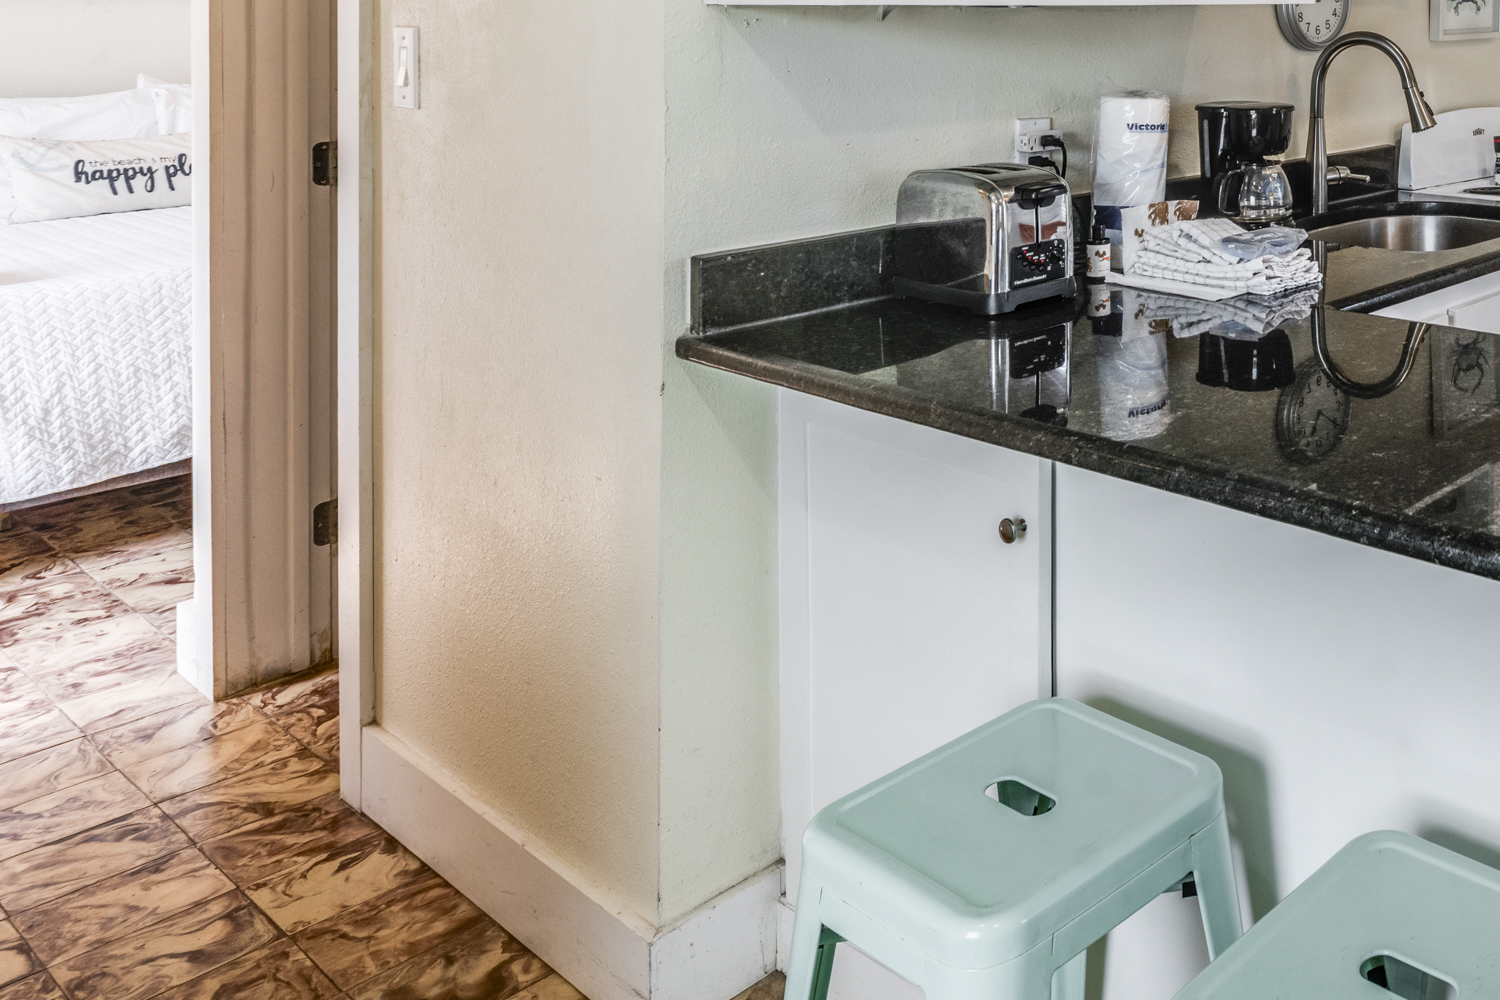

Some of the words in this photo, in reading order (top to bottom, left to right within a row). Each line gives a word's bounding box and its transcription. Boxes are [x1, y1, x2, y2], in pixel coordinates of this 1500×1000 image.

[1298, 12, 1304, 22] 8
[1332, 8, 1337, 18] 4
[1306, 22, 1311, 32] 7
[1325, 19, 1331, 30] 5
[1315, 25, 1321, 35] 6
[88, 159, 109, 168] the
[112, 157, 146, 166] beach
[74, 159, 159, 196] happy
[164, 153, 192, 191] pl
